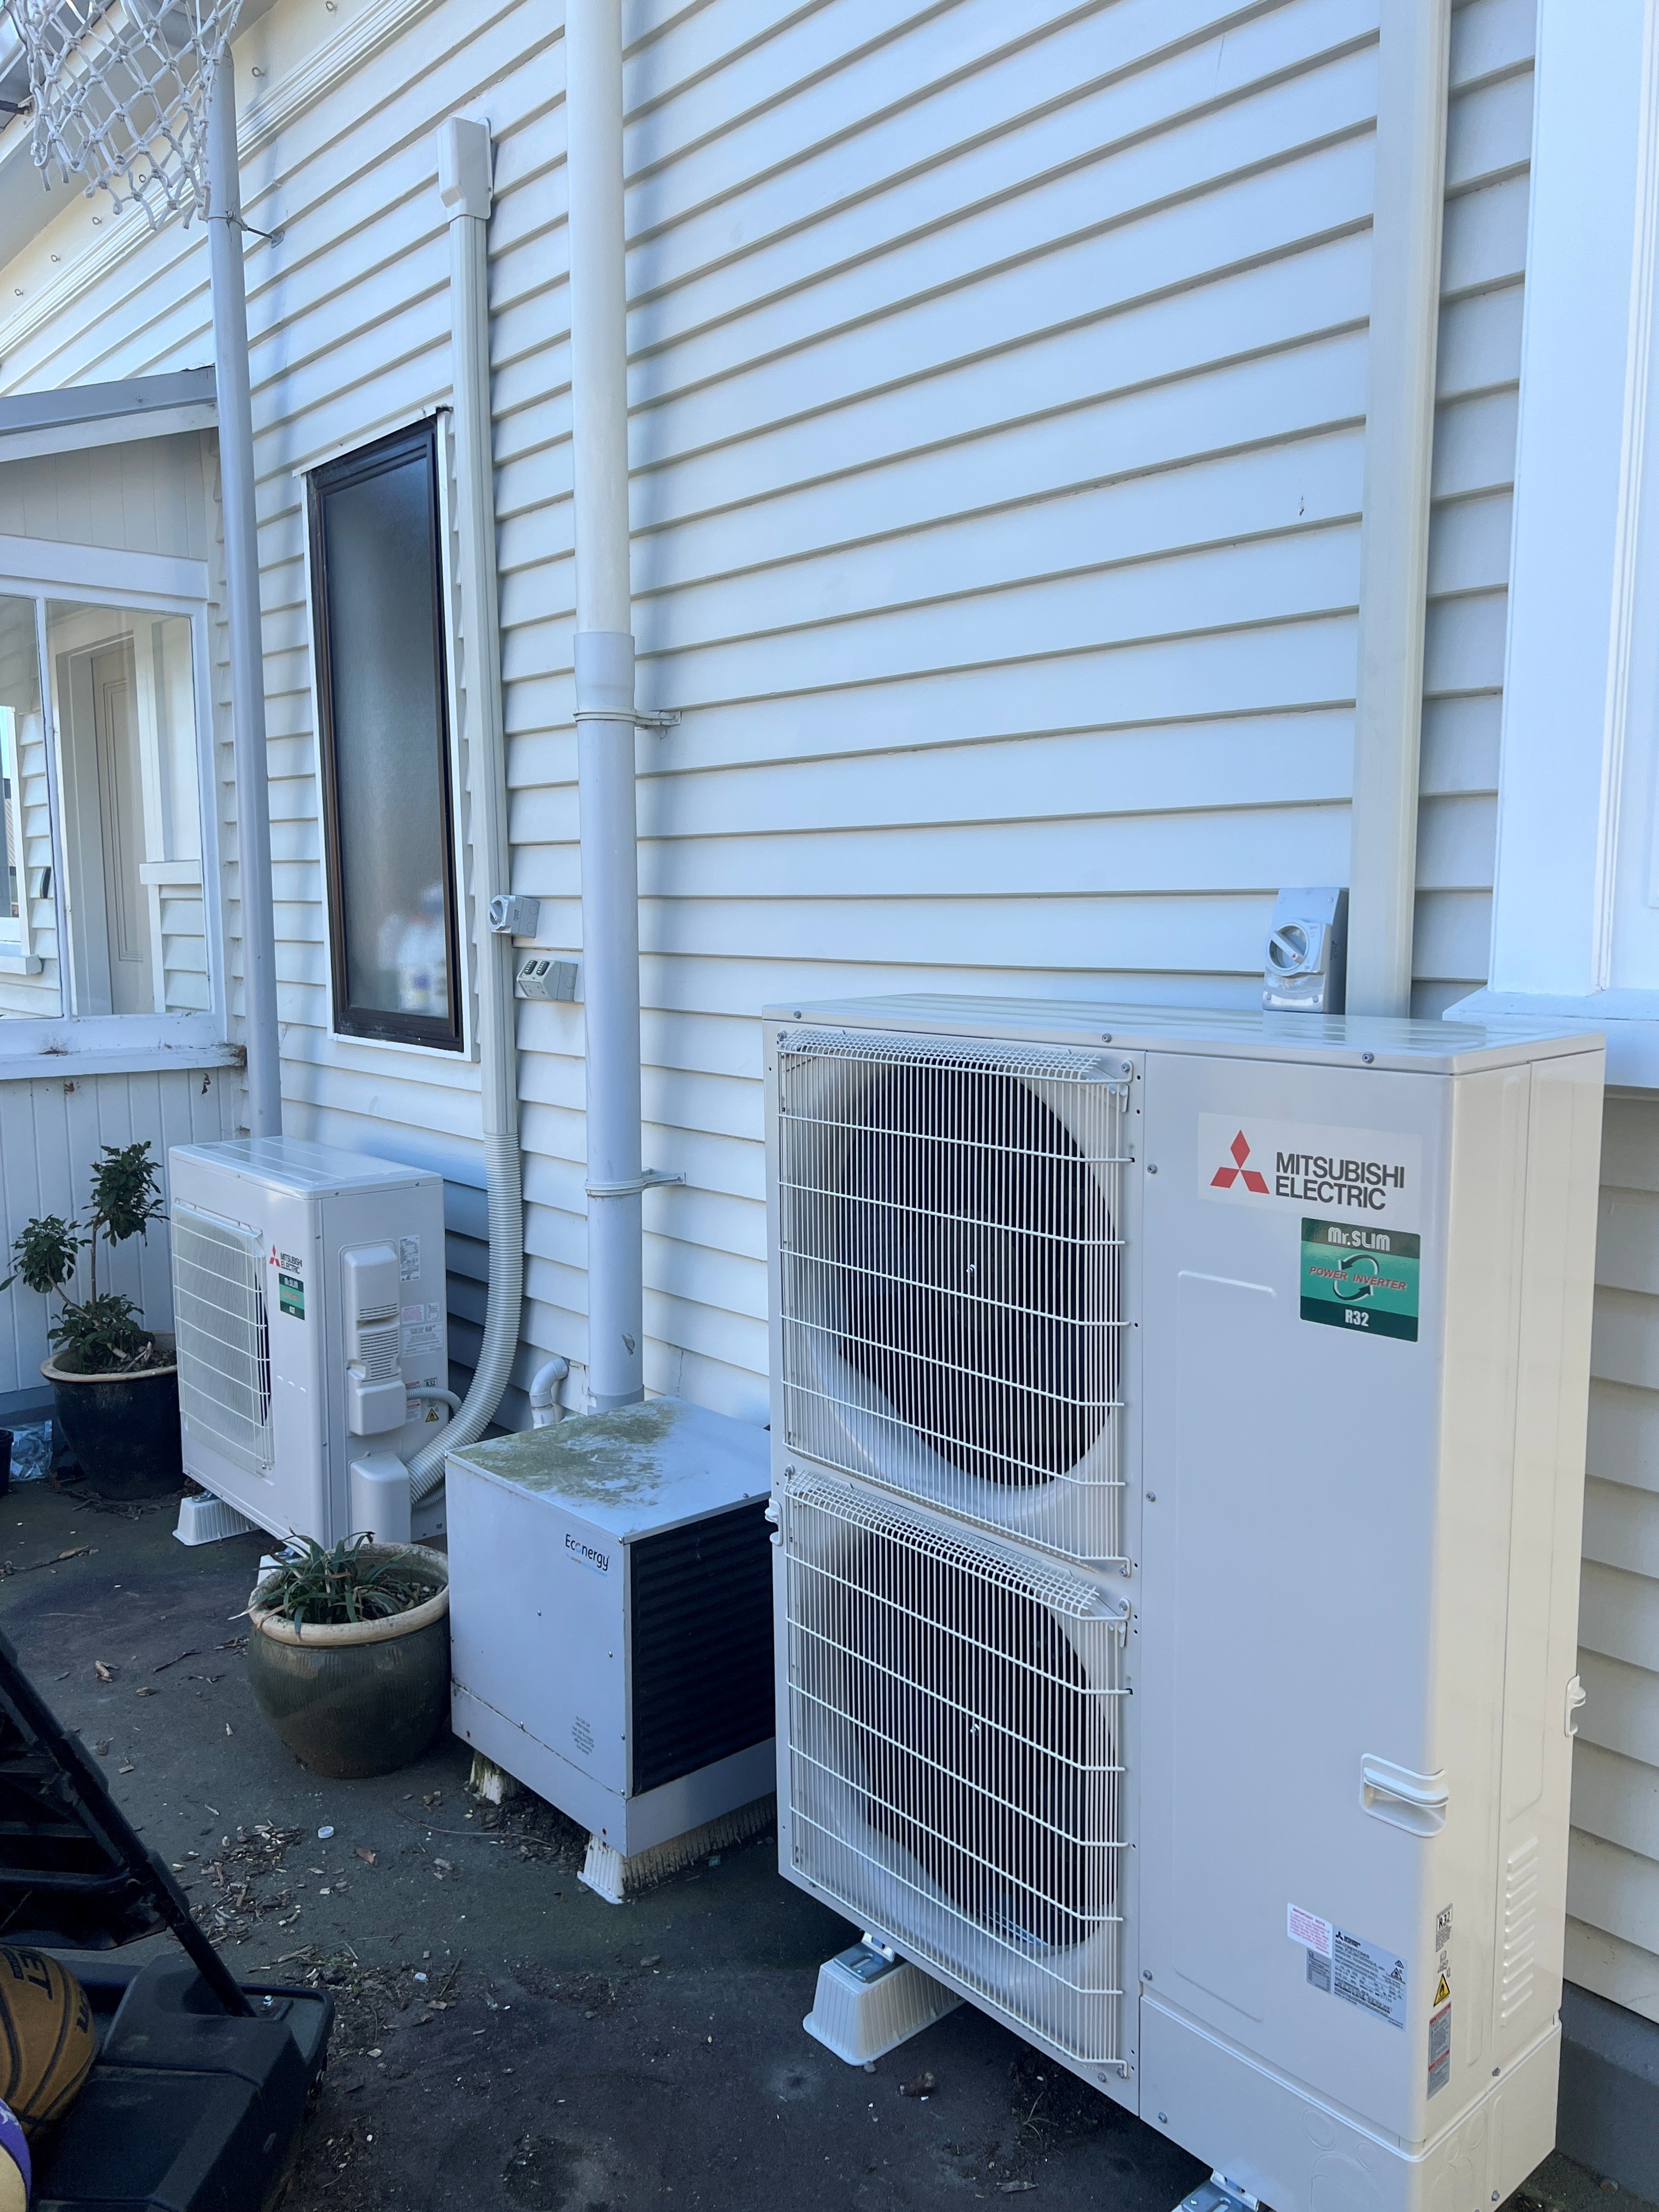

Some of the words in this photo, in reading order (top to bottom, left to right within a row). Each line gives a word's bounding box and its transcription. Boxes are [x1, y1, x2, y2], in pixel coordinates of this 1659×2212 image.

[1277, 1152, 1404, 1188] MITSUBISHI
[1276, 1176, 1386, 1210] ELECTRIC
[1309, 1266, 1347, 1280] POWER
[1353, 1273, 1407, 1290] INVERTER
[1345, 1309, 1369, 1327] R32
[566, 1533, 608, 1571] Econergy
